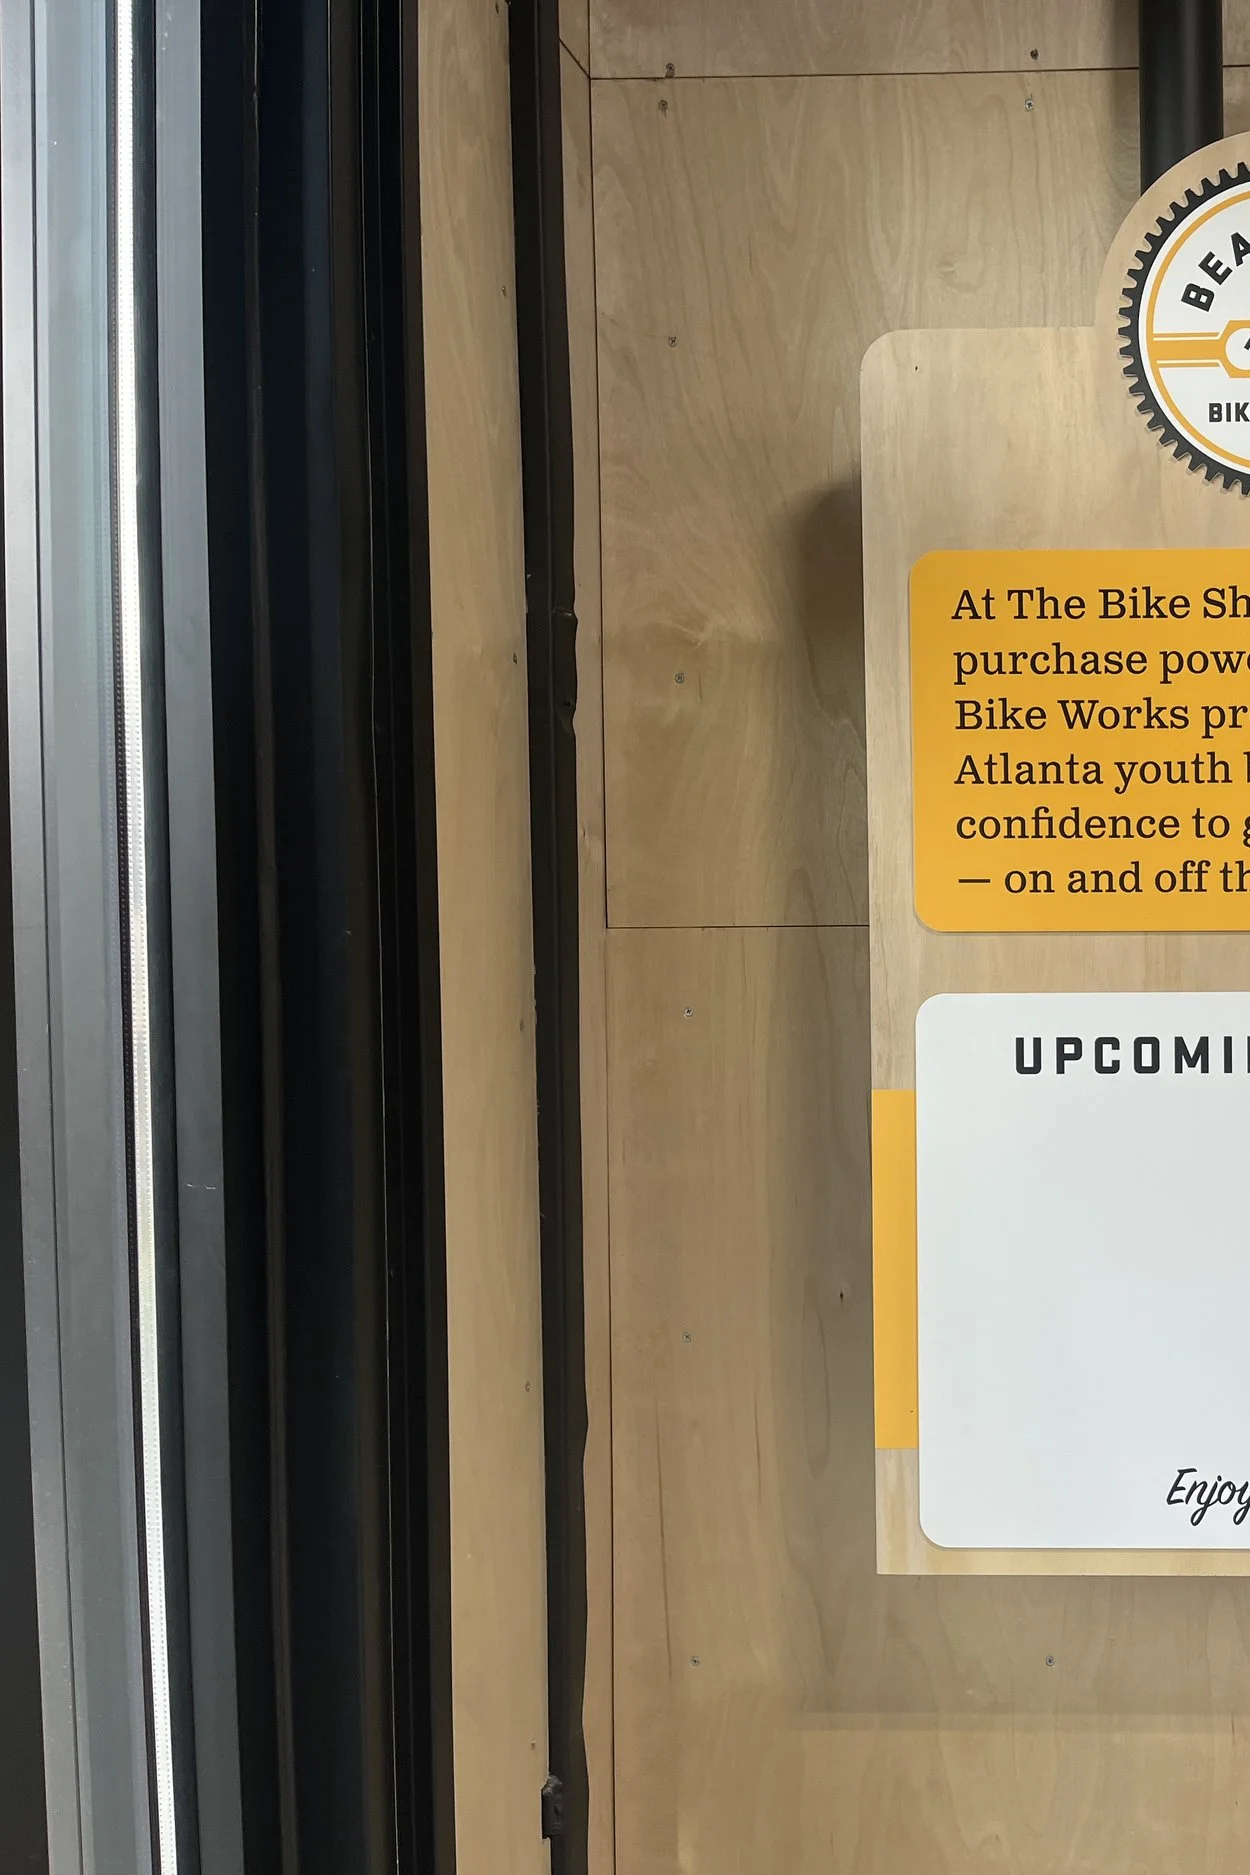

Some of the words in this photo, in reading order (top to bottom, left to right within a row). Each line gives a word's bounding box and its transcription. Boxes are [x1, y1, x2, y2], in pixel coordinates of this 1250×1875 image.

[950, 588, 996, 621] At
[1007, 586, 1086, 620] The
[1098, 585, 1191, 619] Bike
[952, 641, 1148, 686] purchase
[954, 697, 1047, 731] Bike
[1056, 696, 1190, 730] Works
[953, 752, 1104, 785] Atlanta
[1113, 751, 1233, 795] youth
[956, 805, 1180, 840] confidence
[1191, 807, 1230, 839] to
[1004, 870, 1056, 894] on
[1067, 860, 1144, 894] and
[1154, 859, 1211, 893] off
